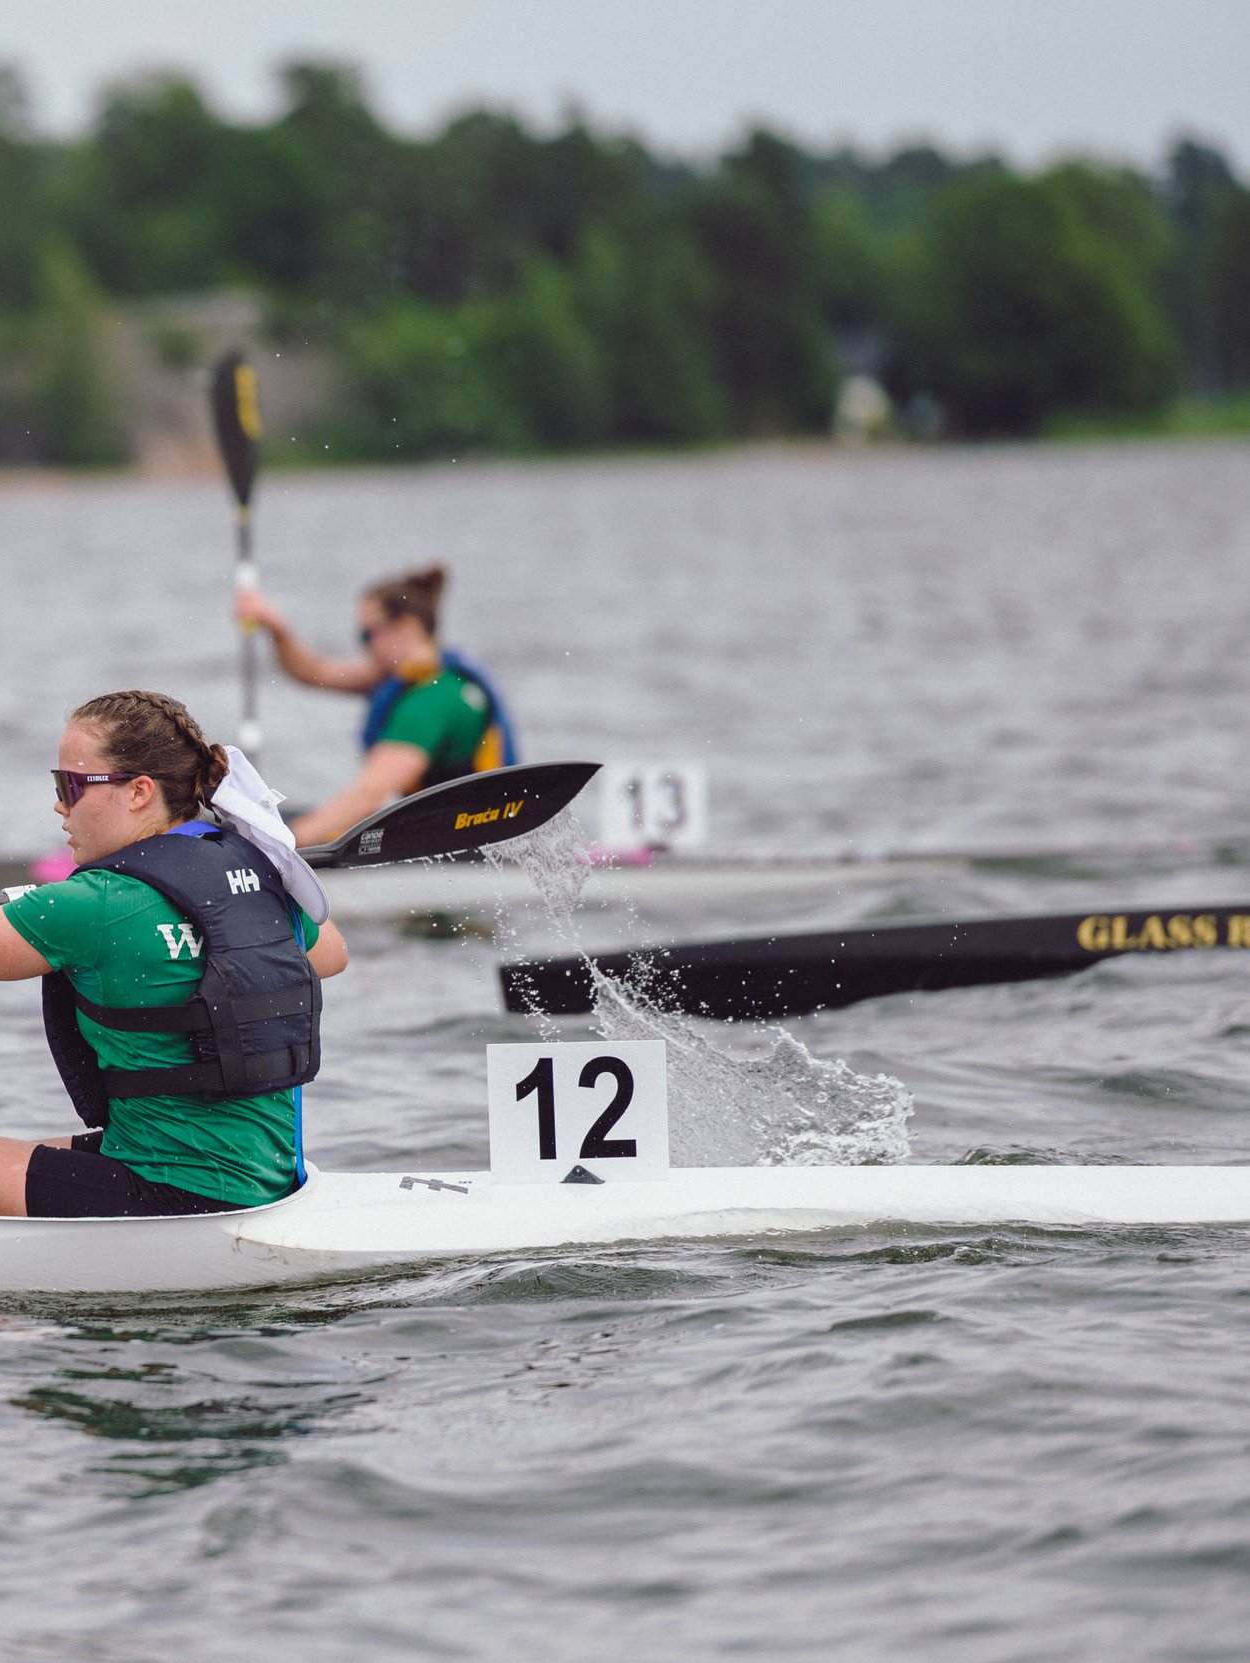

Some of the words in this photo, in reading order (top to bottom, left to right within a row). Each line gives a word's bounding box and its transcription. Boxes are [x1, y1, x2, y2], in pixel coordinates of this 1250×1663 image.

[503, 800, 524, 819] IV
[624, 773, 687, 829] 13
[226, 869, 260, 895] HH
[1077, 914, 1218, 951] GLASS
[516, 1056, 637, 1160] 12
